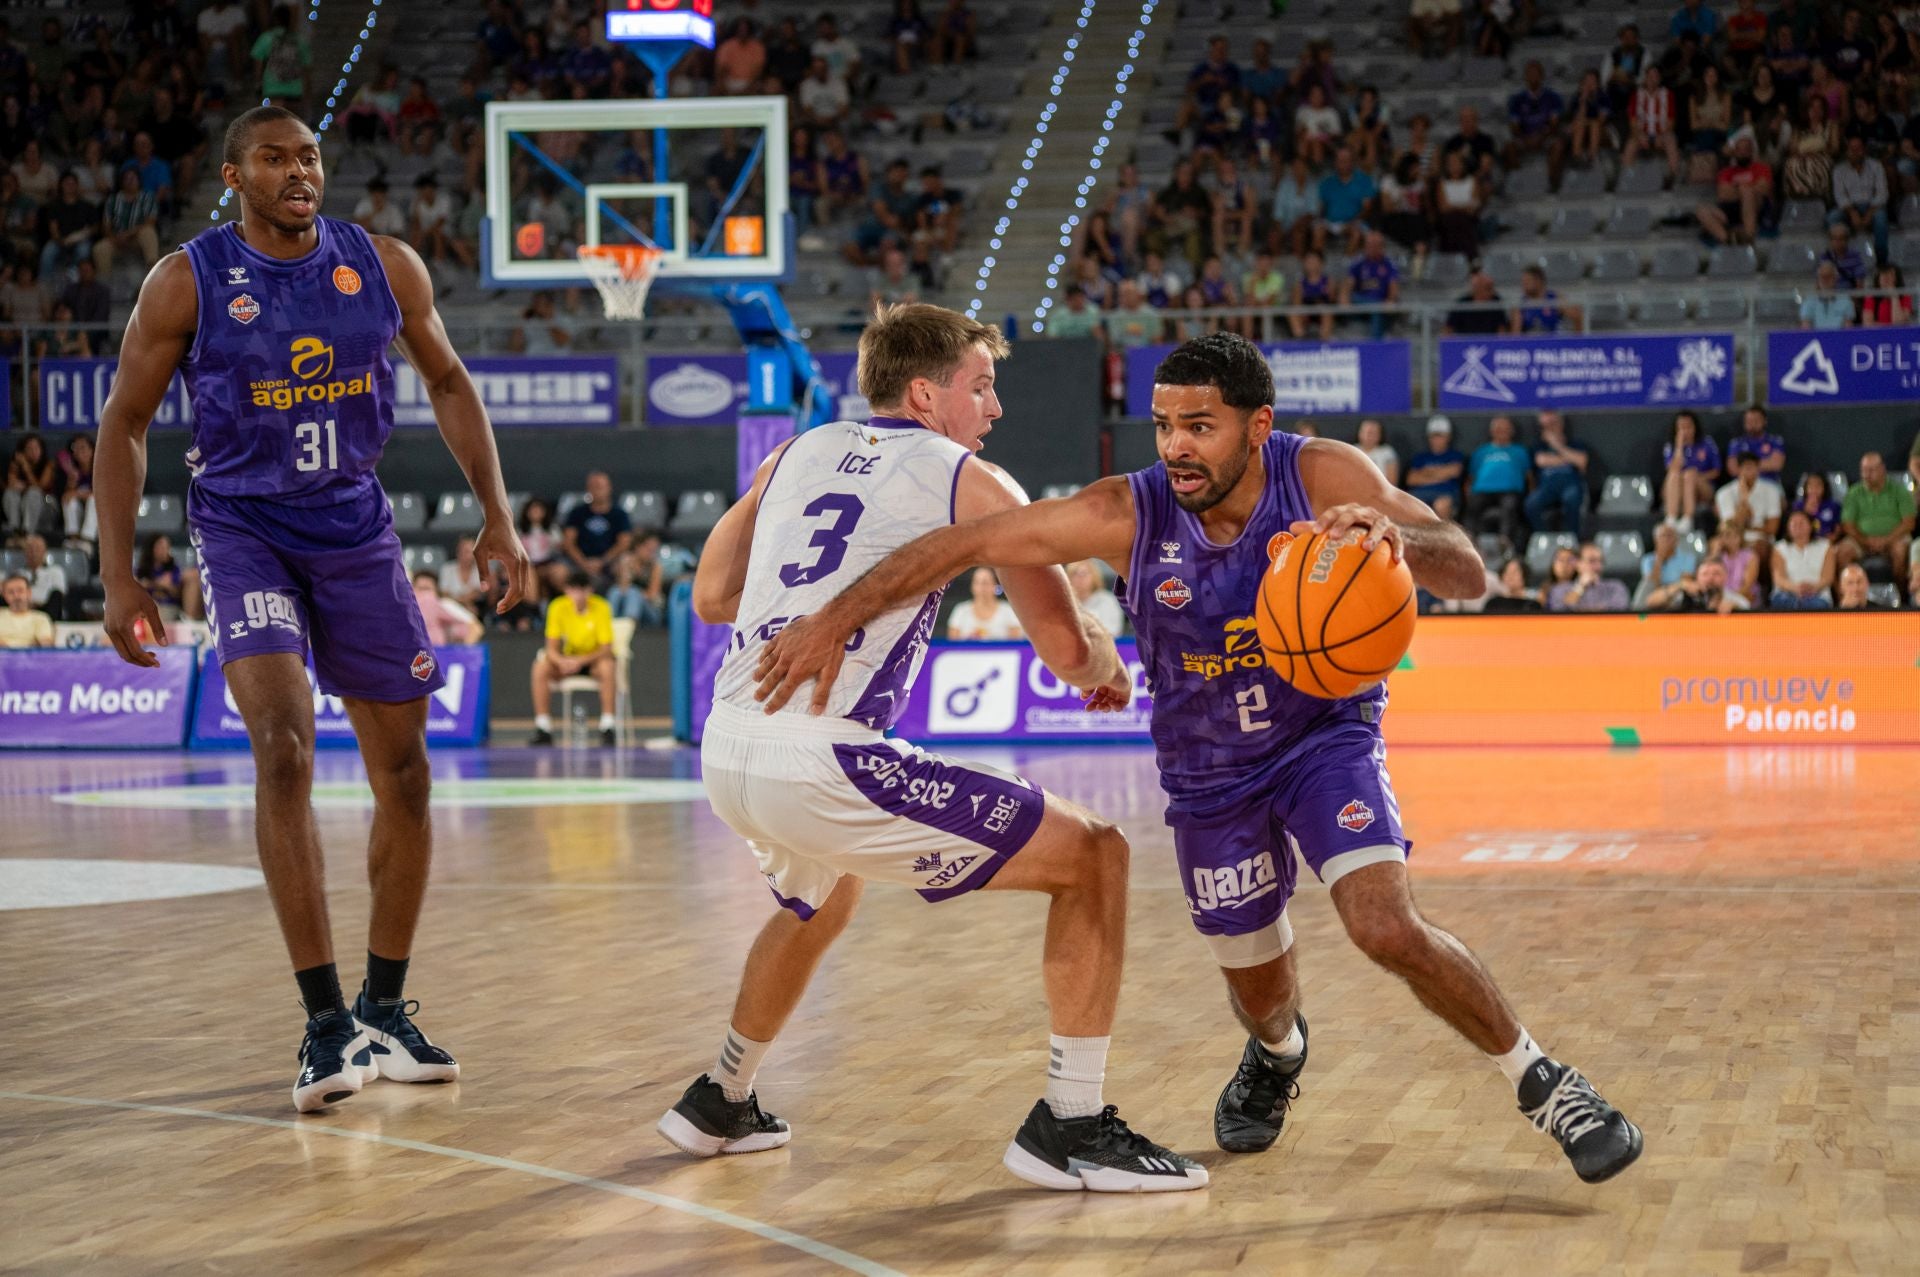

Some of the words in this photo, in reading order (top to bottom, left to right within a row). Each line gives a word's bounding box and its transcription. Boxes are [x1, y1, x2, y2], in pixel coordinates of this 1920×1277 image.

[250, 378, 290, 390] súper
[252, 372, 371, 410] agropal
[295, 419, 338, 471] 31
[836, 451, 881, 474] ICE
[779, 492, 865, 588] 3
[1157, 588, 1191, 600] PALENCIA
[0, 688, 61, 714] nza
[69, 682, 171, 714] Motor
[1235, 684, 1272, 732] 2
[983, 794, 1016, 833] CBC
[999, 800, 1022, 835] VALLADOLID
[1339, 810, 1373, 825] PALENCIA
[926, 854, 979, 887] CRZA
[1193, 851, 1277, 911] gaza
